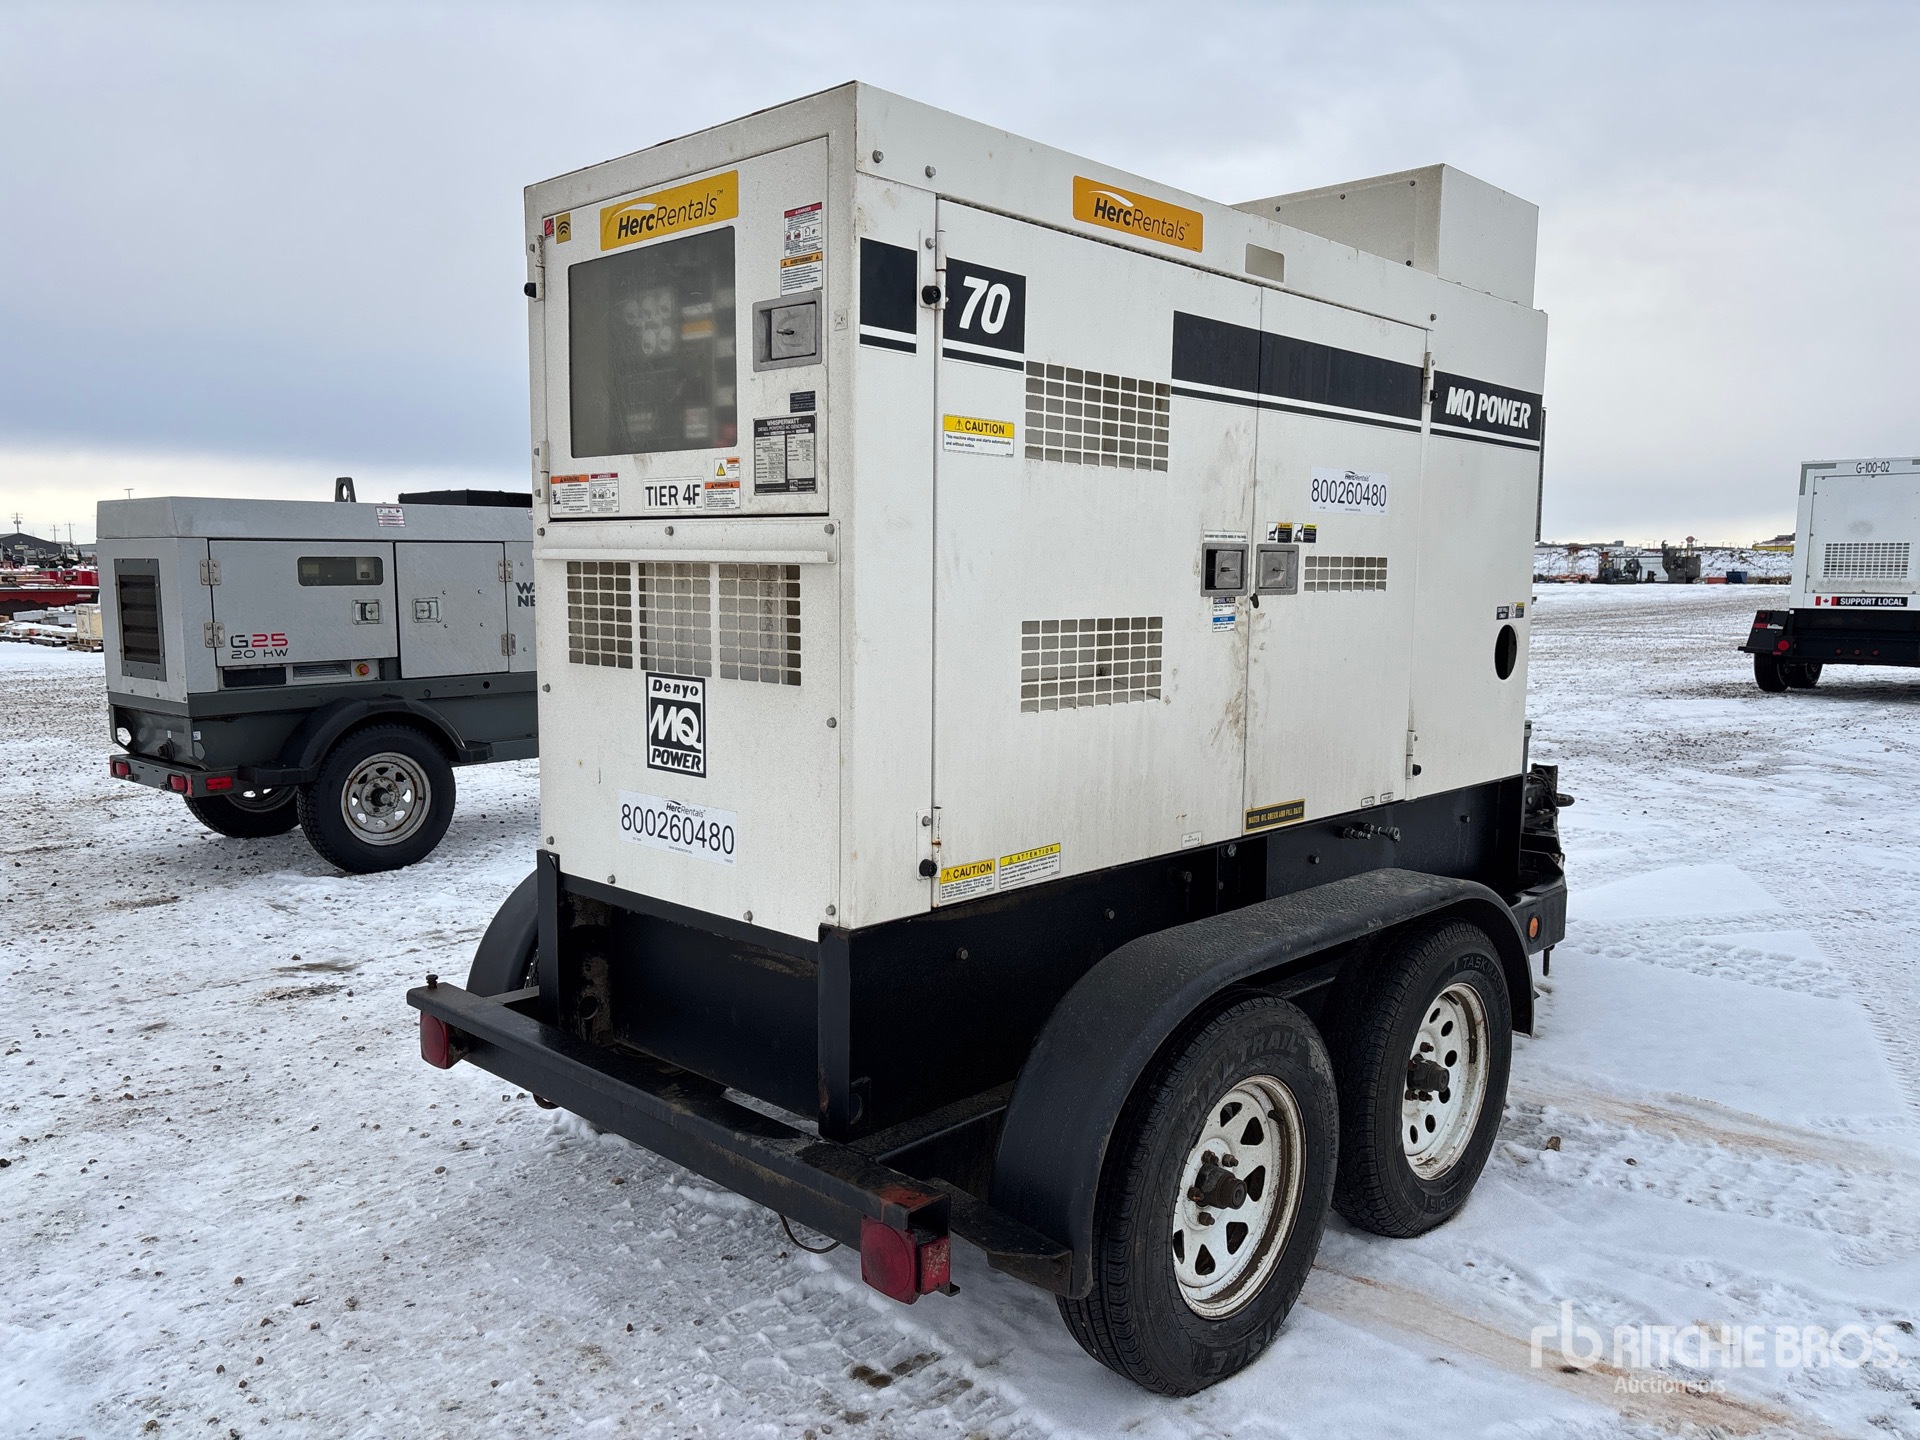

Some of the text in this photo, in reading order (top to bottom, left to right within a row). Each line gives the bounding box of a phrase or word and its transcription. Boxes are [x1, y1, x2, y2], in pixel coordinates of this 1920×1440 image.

[958, 275, 1011, 335] 70
[1445, 386, 1532, 430] MQ POWER
[965, 420, 1005, 435] CAUTION
[1856, 461, 1891, 474] G-100-02
[645, 485, 678, 506] TIER
[682, 484, 701, 506] 4F
[1311, 478, 1387, 507] 800260480
[1840, 597, 1904, 606] SUPPORT LOCAL
[230, 633, 289, 649] G25
[231, 649, 256, 659] 20
[652, 679, 699, 699] Denyo
[650, 704, 702, 750] MQ
[651, 747, 702, 771] POWER
[621, 803, 735, 855] 800260480
[1016, 846, 1054, 861] ATTENTION
[953, 862, 992, 879] CAUTION
